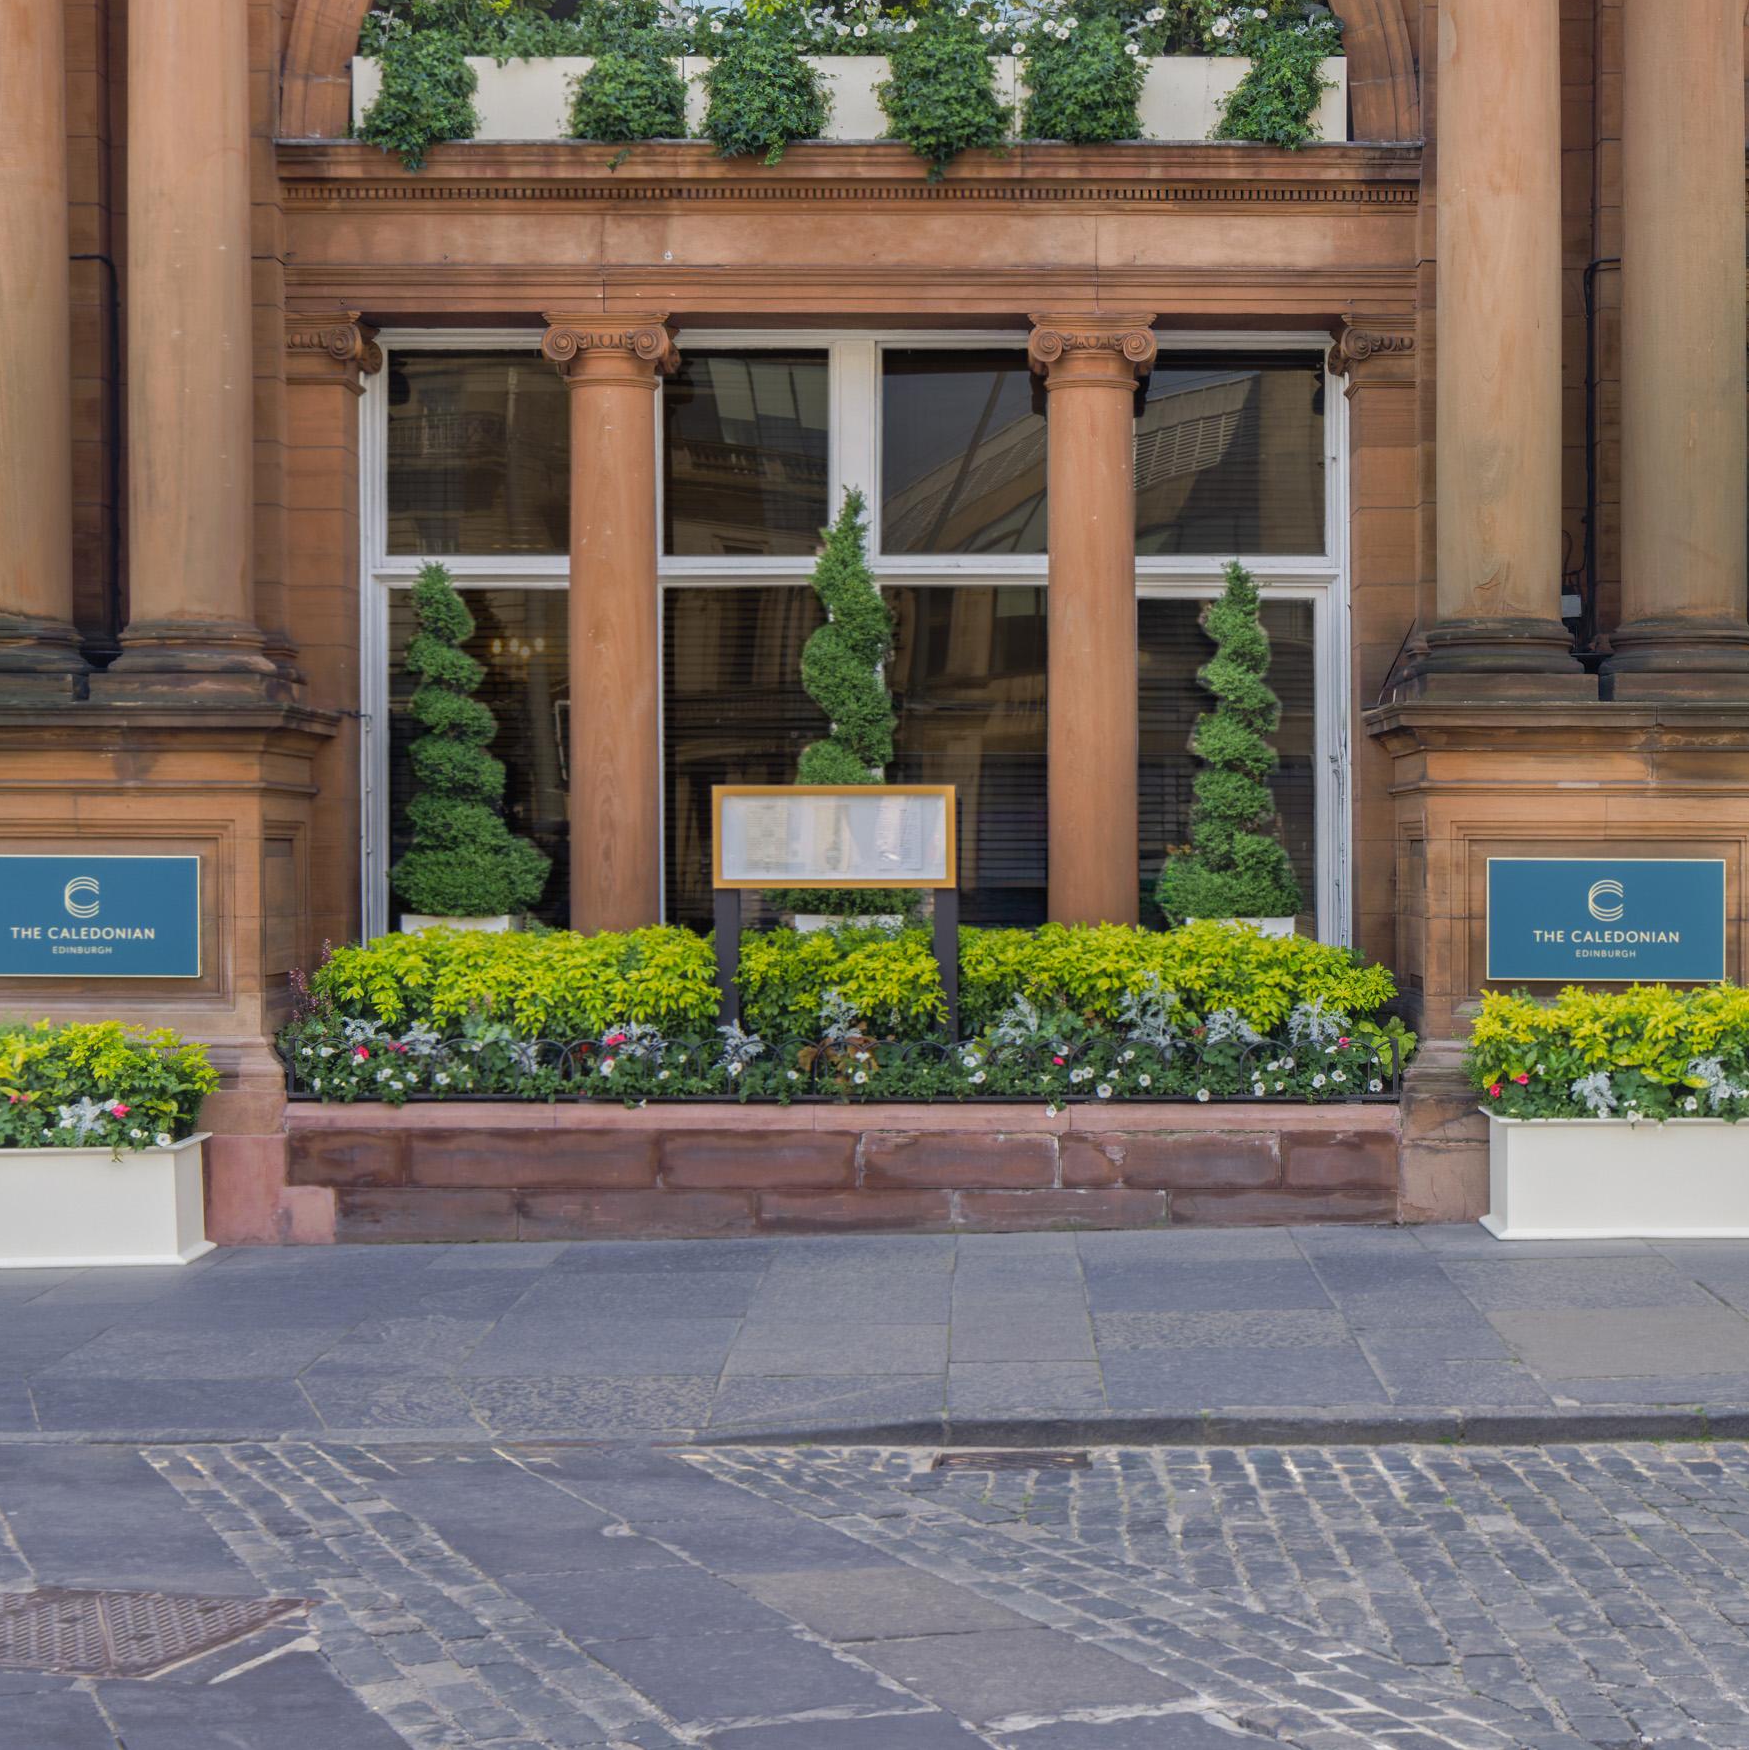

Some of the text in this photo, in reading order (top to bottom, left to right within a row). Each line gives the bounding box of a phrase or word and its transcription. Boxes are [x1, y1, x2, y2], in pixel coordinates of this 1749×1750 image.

[10, 926, 156, 940] THE CALEDONIAN
[1532, 930, 1681, 944] THE CALEDONIAN
[51, 946, 113, 955] EDINBURGH
[1575, 949, 1637, 958] EDINBURGH
